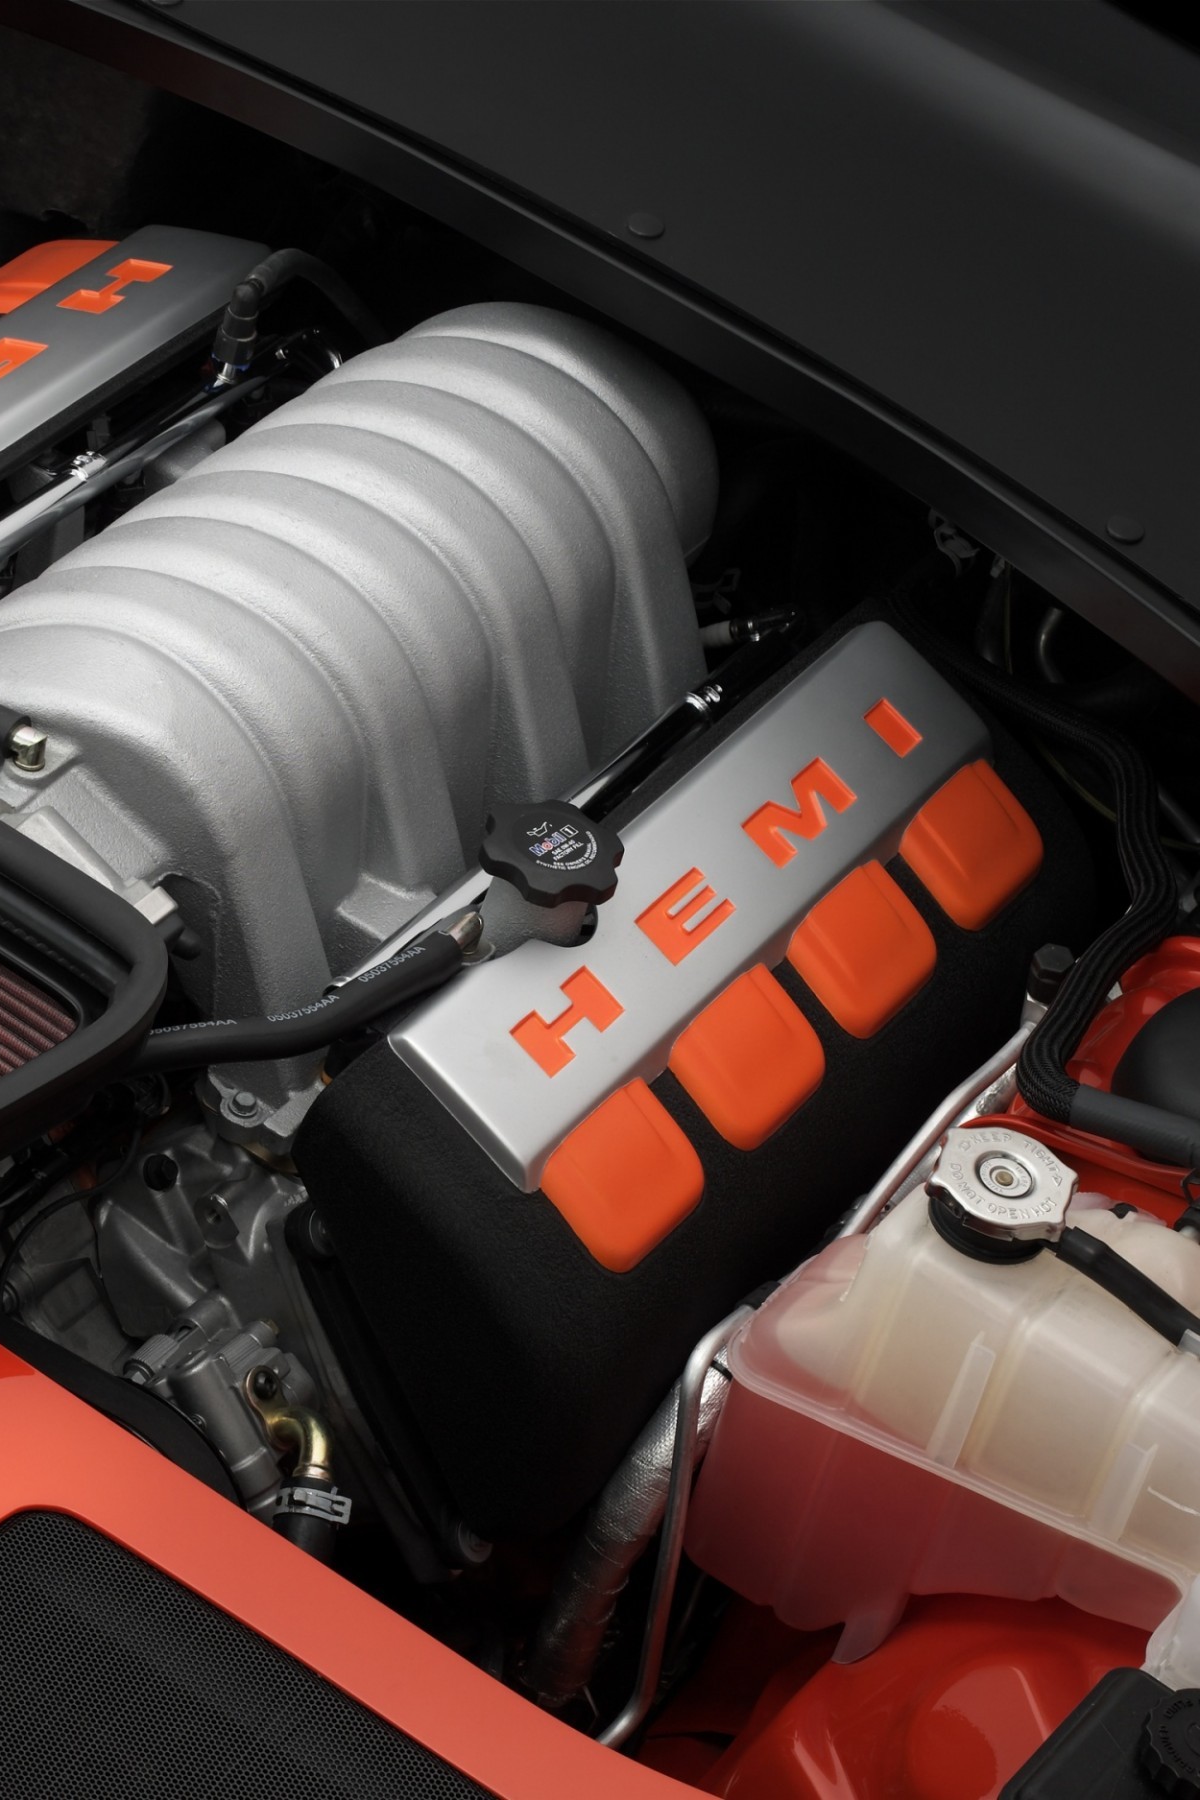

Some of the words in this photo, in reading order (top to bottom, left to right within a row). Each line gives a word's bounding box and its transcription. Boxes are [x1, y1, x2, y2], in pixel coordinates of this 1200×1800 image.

[529, 832, 567, 856] Mobil
[553, 847, 574, 860] FACTORY
[574, 842, 584, 850] FILL
[509, 697, 922, 1078] HEMI
[357, 945, 427, 984] 05037554AA
[266, 992, 340, 1023] 05037554AA
[1023, 1140, 1061, 1173] TIGHT
[958, 1181, 985, 1205] NOT
[987, 1203, 1031, 1220] OPEN
[1031, 1197, 1057, 1217] HOT
